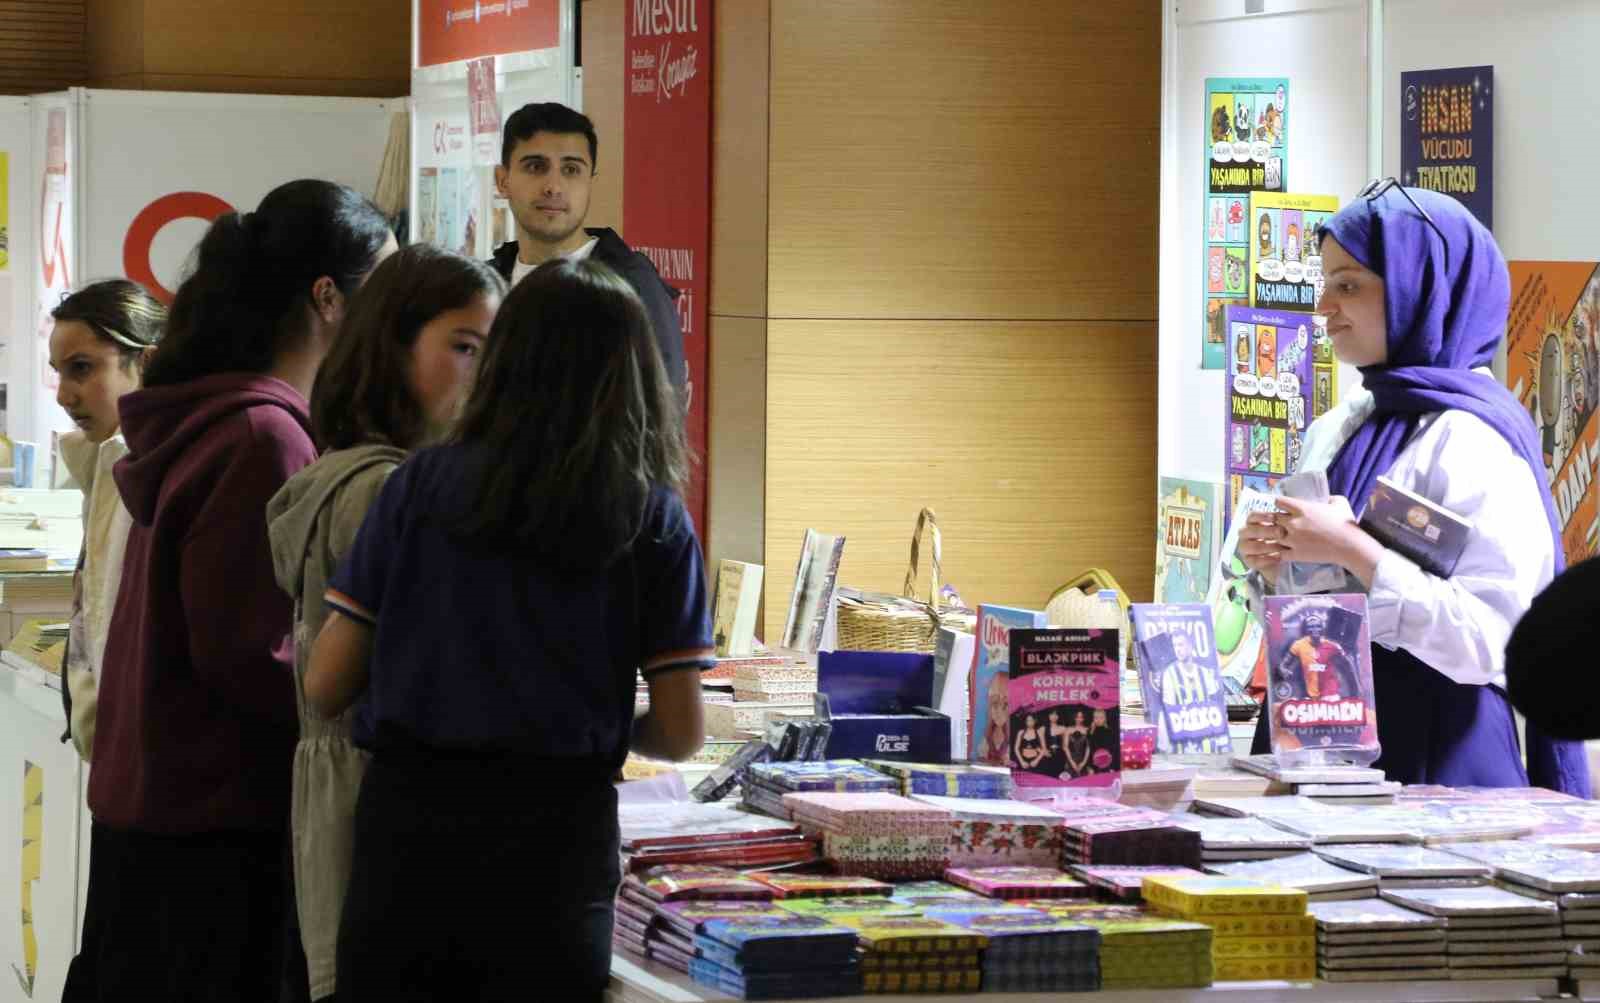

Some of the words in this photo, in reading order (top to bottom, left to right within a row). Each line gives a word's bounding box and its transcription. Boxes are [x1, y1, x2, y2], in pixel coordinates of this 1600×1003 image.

[632, 0, 698, 37] Mesut
[1422, 136, 1473, 160] VÜCUDU
[1167, 515, 1200, 550] ATLAS
[1032, 675, 1096, 689] KORKAK
[1036, 690, 1089, 702] MELEK
